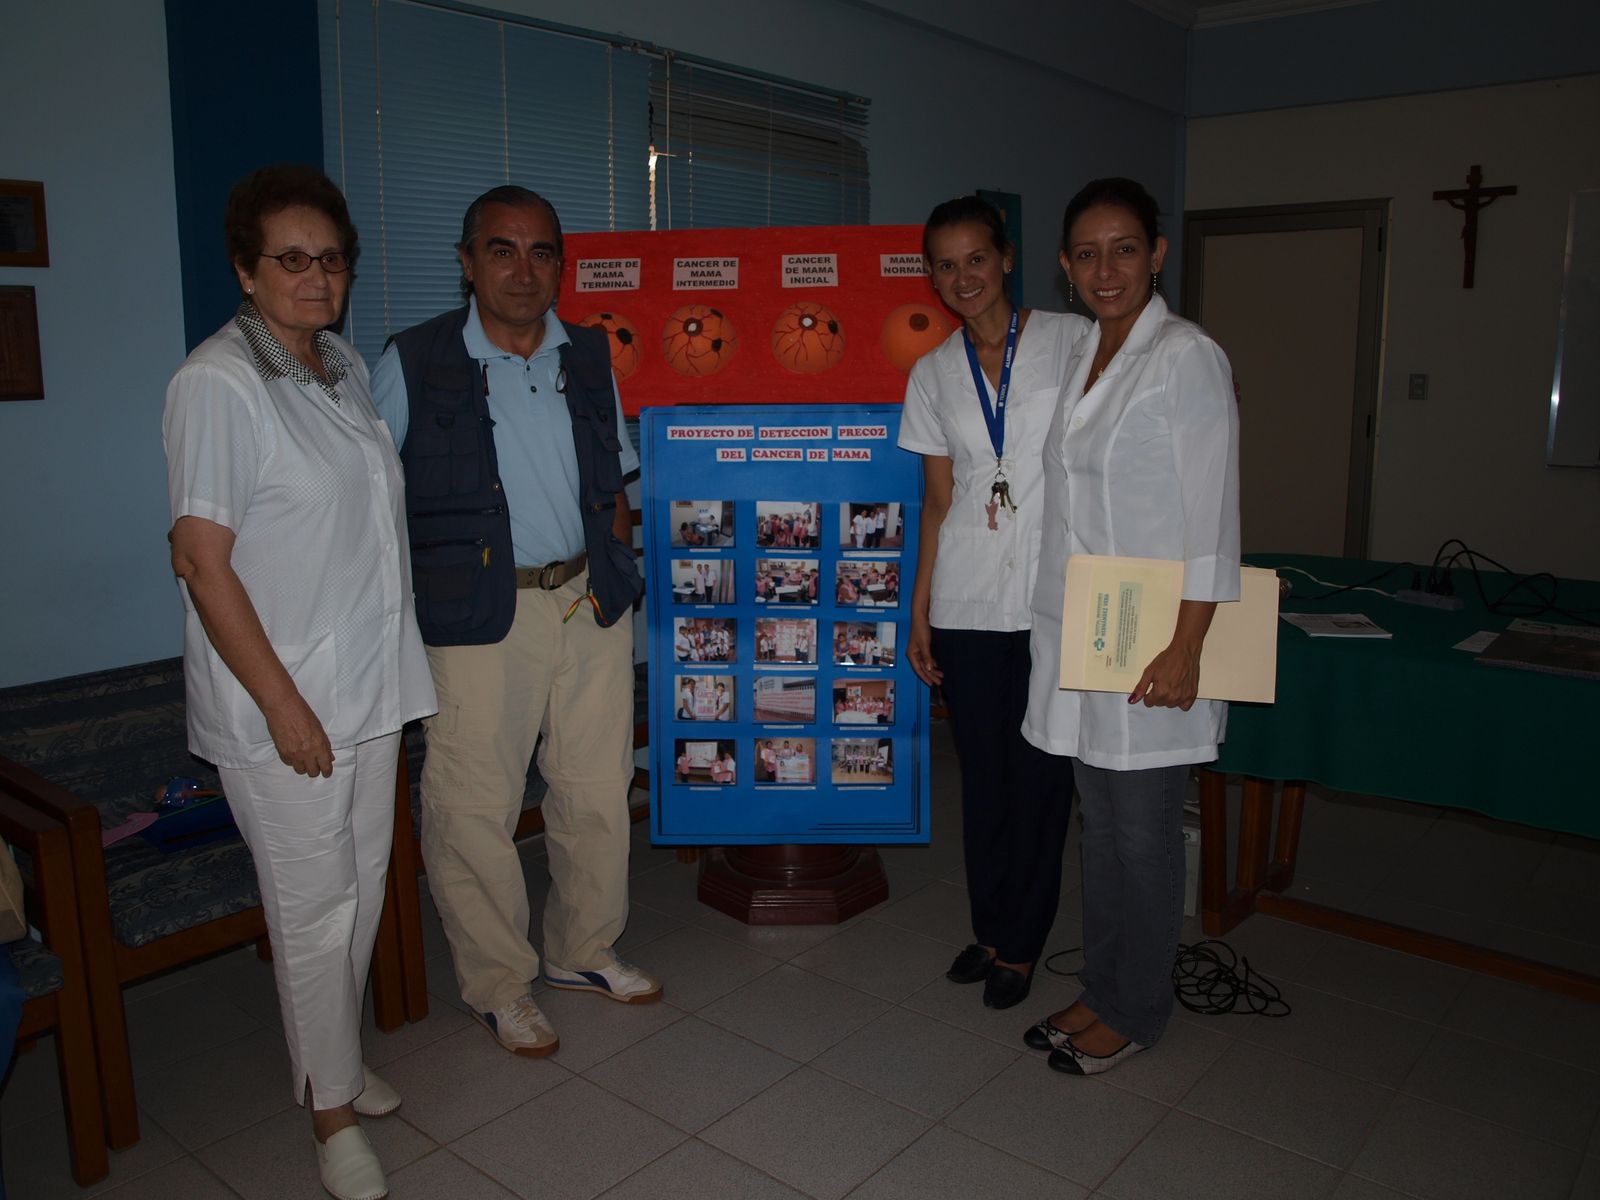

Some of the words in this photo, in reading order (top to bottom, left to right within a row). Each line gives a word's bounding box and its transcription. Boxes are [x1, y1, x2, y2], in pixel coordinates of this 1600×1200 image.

[676, 260, 720, 268] CANCER
[723, 260, 737, 268] DE
[788, 256, 831, 265] CANCER
[889, 256, 922, 264] MAMA
[579, 261, 622, 270] CANCER
[625, 260, 639, 268] DE
[690, 270, 722, 278] MAMA
[785, 266, 799, 274] DE
[802, 266, 834, 274] MAMA
[592, 271, 624, 279] MAMA
[581, 280, 635, 289] TERMINAL
[676, 279, 736, 287] INTERMEDIO
[790, 276, 829, 285] INICIAL
[670, 428, 734, 438] PROYECTO
[737, 428, 754, 438] DE
[760, 428, 828, 439] DETECCION
[839, 427, 886, 437] PRECOZ
[721, 450, 744, 459] DEL
[752, 449, 802, 459] CANCER
[809, 450, 825, 459] DE
[833, 450, 870, 459] MAMA
